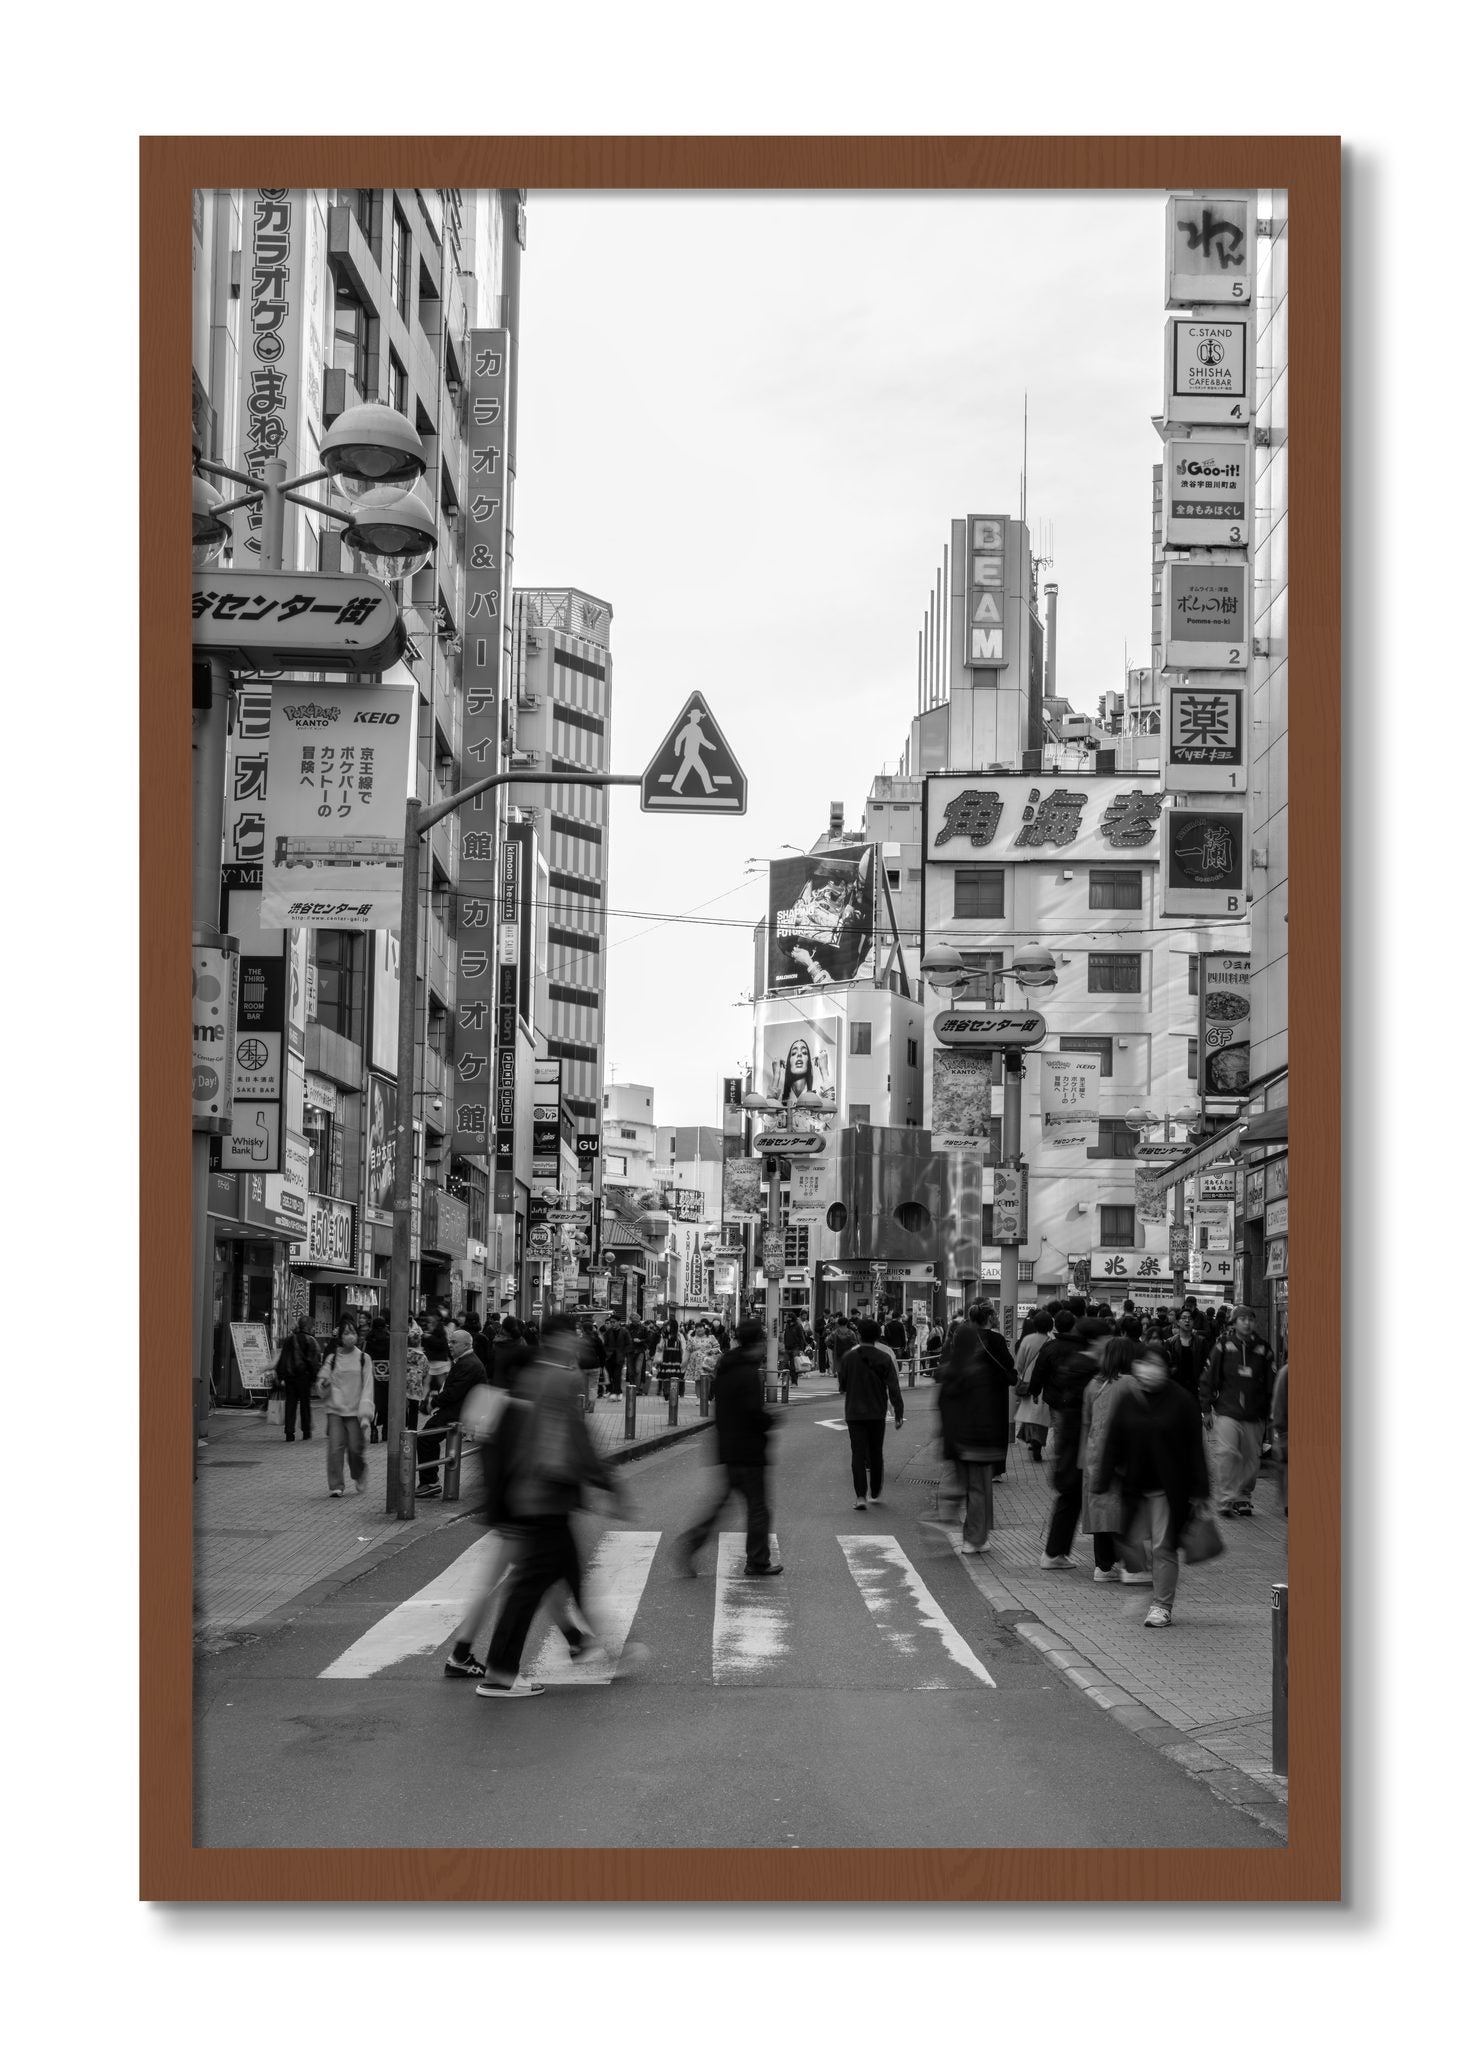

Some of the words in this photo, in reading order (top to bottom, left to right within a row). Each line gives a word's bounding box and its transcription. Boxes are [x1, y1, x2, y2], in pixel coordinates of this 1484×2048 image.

[251, 201, 292, 333] カラオケ
[1231, 282, 1244, 298] 5
[1188, 328, 1233, 337] C.STAND
[1188, 367, 1232, 378] SHISHA
[1188, 378, 1232, 386] CAFE&BAR
[1230, 404, 1242, 419] 4
[1187, 461, 1240, 477] Goo-it!
[1180, 480, 1237, 489] 渋谷宇田川町店
[1176, 504, 1241, 516] 全身もみほぐし
[1229, 526, 1241, 542] 3
[974, 519, 1003, 659] BEAM
[1177, 595, 1238, 614] ポムの樹
[1229, 649, 1240, 664] 2
[295, 719, 329, 727] KANTO
[353, 711, 401, 725] KEIO
[1180, 696, 1229, 745] 薬
[1174, 748, 1234, 762] マツモトキヨシ
[300, 745, 315, 788] 冒険へ
[317, 746, 335, 818] カントーの
[358, 747, 375, 805] 京王線で
[1228, 772, 1236, 788] 1
[933, 788, 1164, 848] 角海老
[1174, 826, 1233, 873] 一蘭
[505, 846, 515, 880] kimono
[505, 884, 514, 918] hearts
[1227, 896, 1239, 912] B
[287, 902, 374, 916] 渋谷センター街
[244, 975, 266, 983] THIRD
[940, 1019, 1040, 1032] 渋谷センター街
[1206, 1028, 1233, 1047] 6F
[198, 1075, 218, 1089] Day!
[232, 1137, 265, 1148] Whisky
[578, 1140, 598, 1151] GU
[757, 1137, 817, 1146] 渋谷センター街
[231, 1146, 252, 1155] Bank
[692, 1254, 701, 1294] BEER
